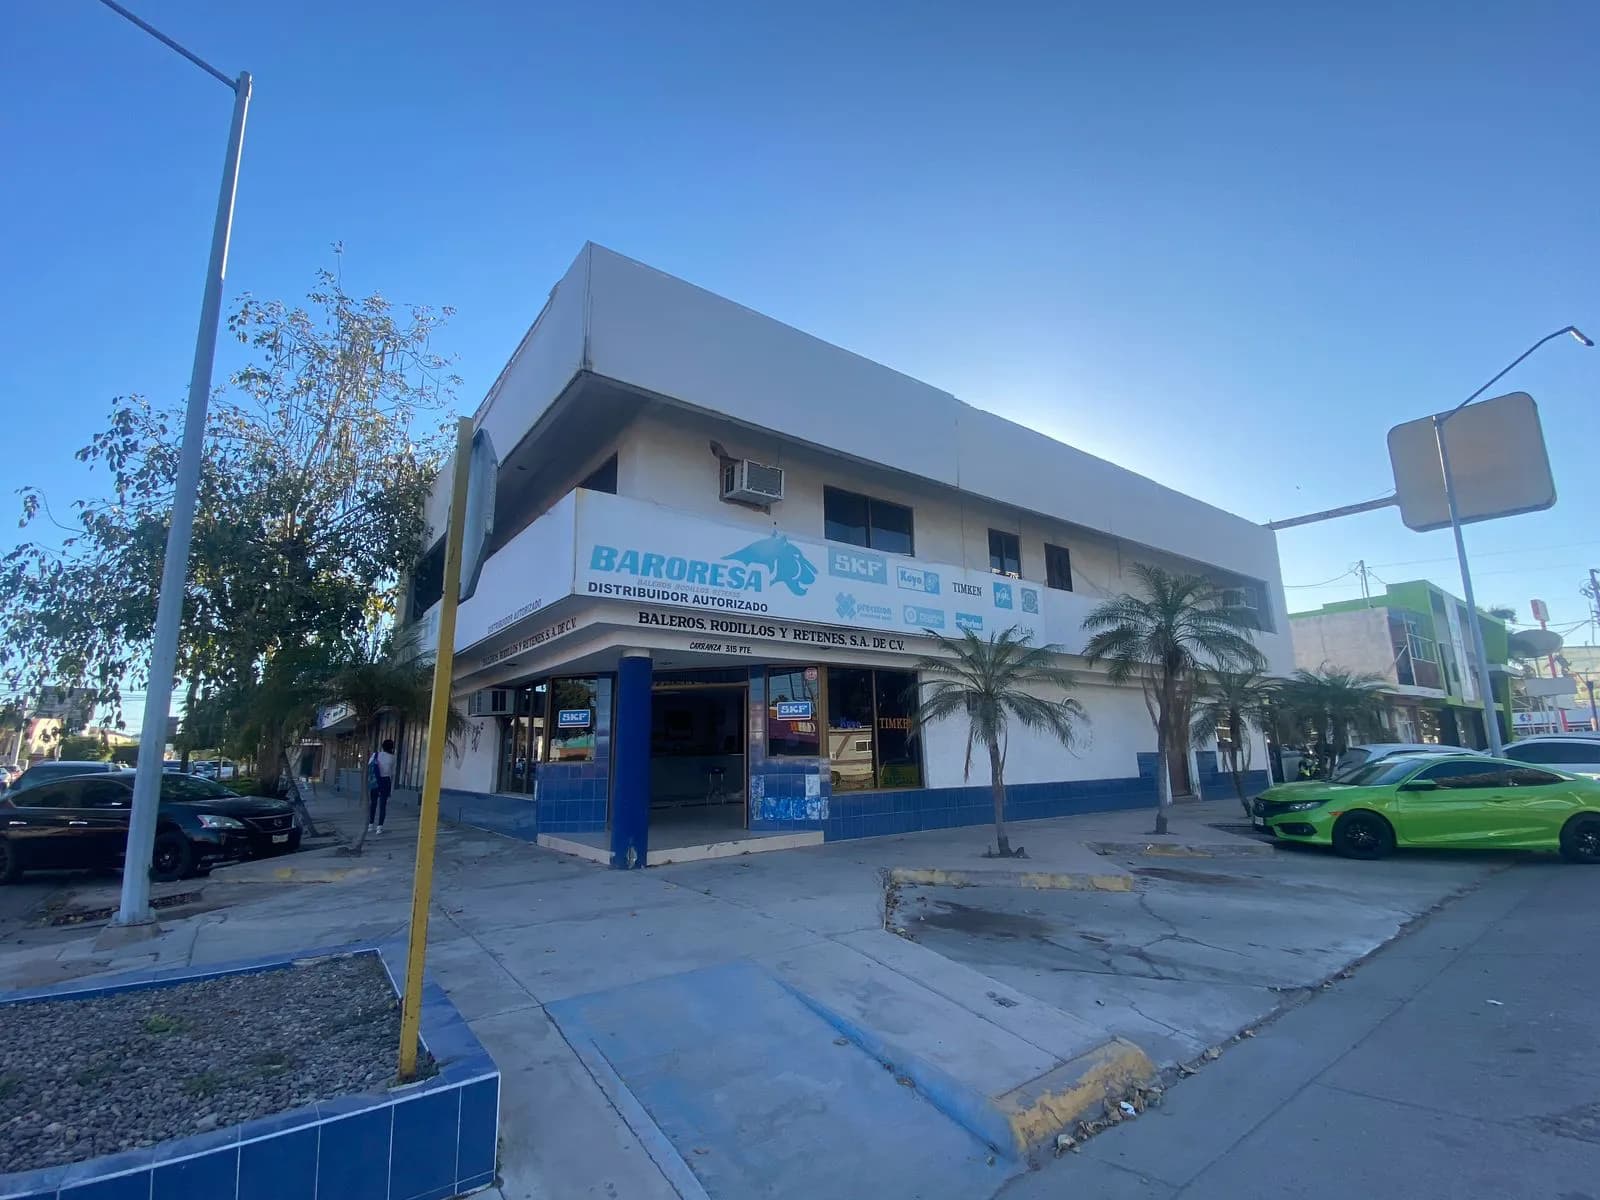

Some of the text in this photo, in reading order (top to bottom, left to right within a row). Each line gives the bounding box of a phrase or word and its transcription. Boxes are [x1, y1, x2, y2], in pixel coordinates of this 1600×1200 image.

[590, 545, 762, 593] BARORESA
[834, 554, 883, 577] SKF
[899, 569, 922, 585] Koyo
[952, 580, 982, 597] TIMKEN
[588, 582, 768, 613] DISTRIBUIDOR AUTORIZADO
[513, 598, 542, 619] AUTORIZADO
[557, 623, 564, 635] DE
[710, 620, 776, 637] RODILLOS
[779, 627, 788, 639] Y
[873, 637, 887, 649] DE
[689, 641, 722, 652] CARRANZA
[725, 644, 737, 653] 315
[562, 712, 586, 721] SKF
[781, 704, 807, 715] SKF
